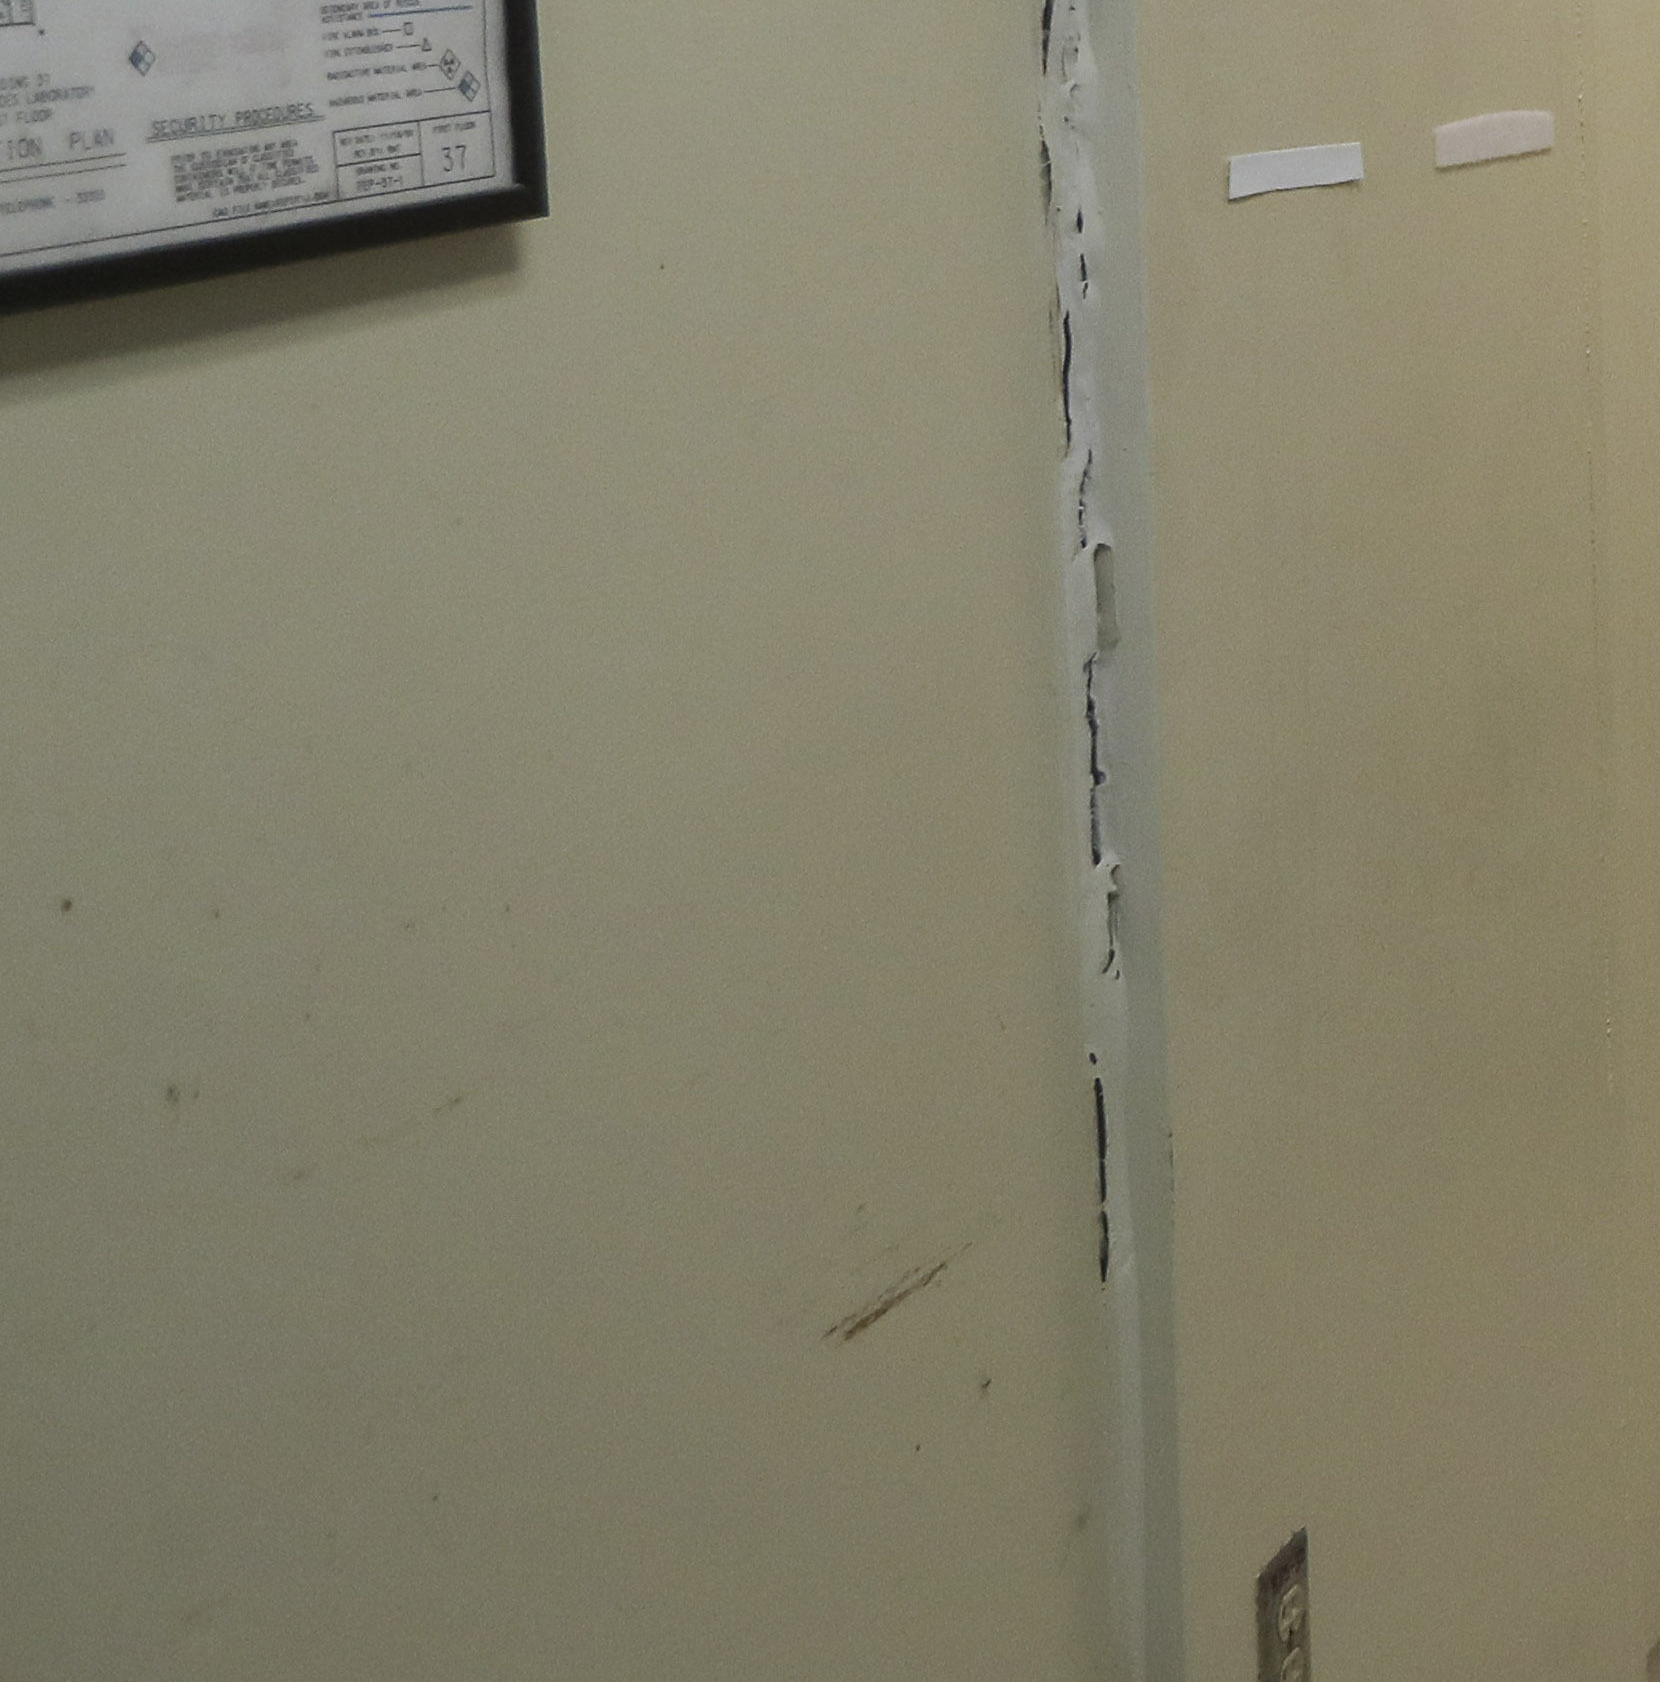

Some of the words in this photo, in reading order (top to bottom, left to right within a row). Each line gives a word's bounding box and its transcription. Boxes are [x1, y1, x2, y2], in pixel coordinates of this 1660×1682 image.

[152, 114, 226, 137] SECURITY
[234, 102, 314, 127] PROCEDURES
[69, 128, 115, 150] PLAN
[441, 145, 467, 172] 37
